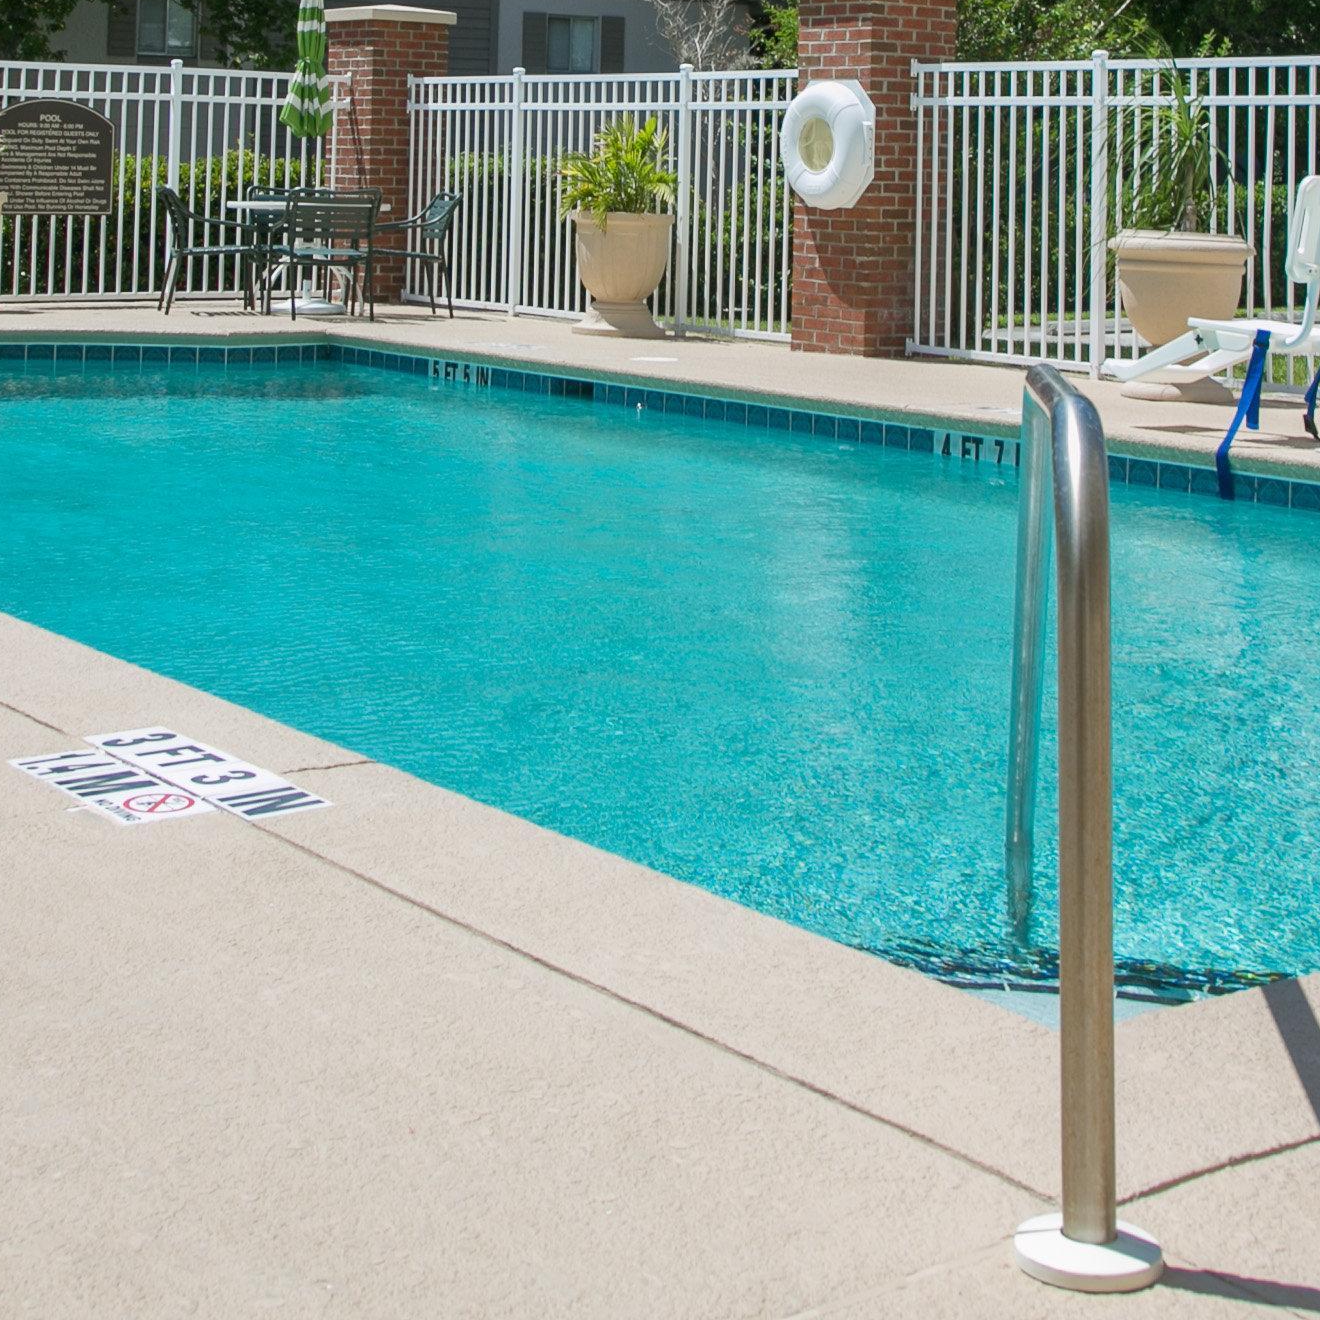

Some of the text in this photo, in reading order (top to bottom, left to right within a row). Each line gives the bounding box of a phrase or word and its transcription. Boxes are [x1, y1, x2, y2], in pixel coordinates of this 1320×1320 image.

[40, 114, 62, 123] POOL
[445, 362, 458, 381] FT
[476, 366, 489, 385] IN
[941, 433, 1005, 464] 4 FT 7
[101, 732, 325, 817] 3 FT 3 IN
